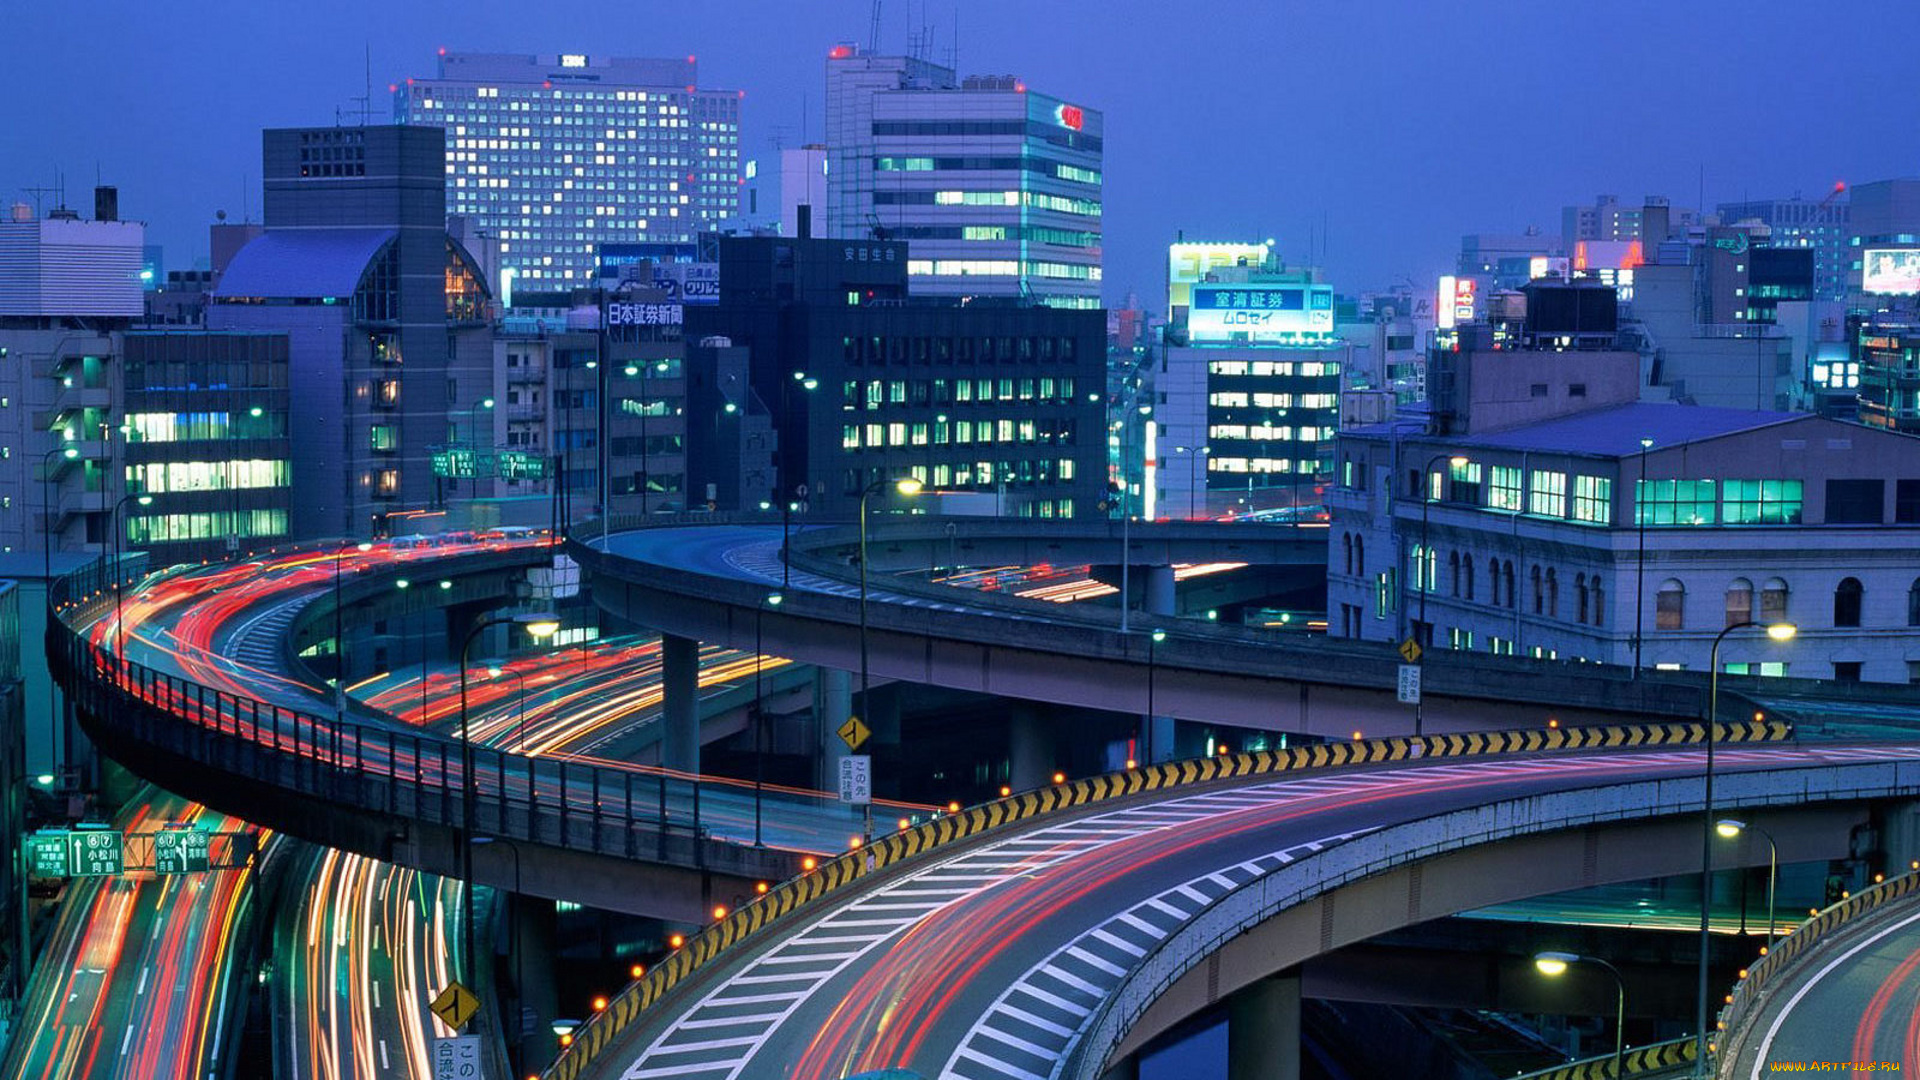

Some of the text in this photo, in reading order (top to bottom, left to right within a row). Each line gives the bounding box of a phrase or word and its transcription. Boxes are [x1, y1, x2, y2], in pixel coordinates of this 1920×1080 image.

[1214, 291, 1284, 308] 室清証券
[608, 303, 683, 325] 日本証券新聞
[1223, 311, 1274, 325] ムロセイ
[855, 761, 866, 796] この先
[88, 849, 118, 861] 小松川
